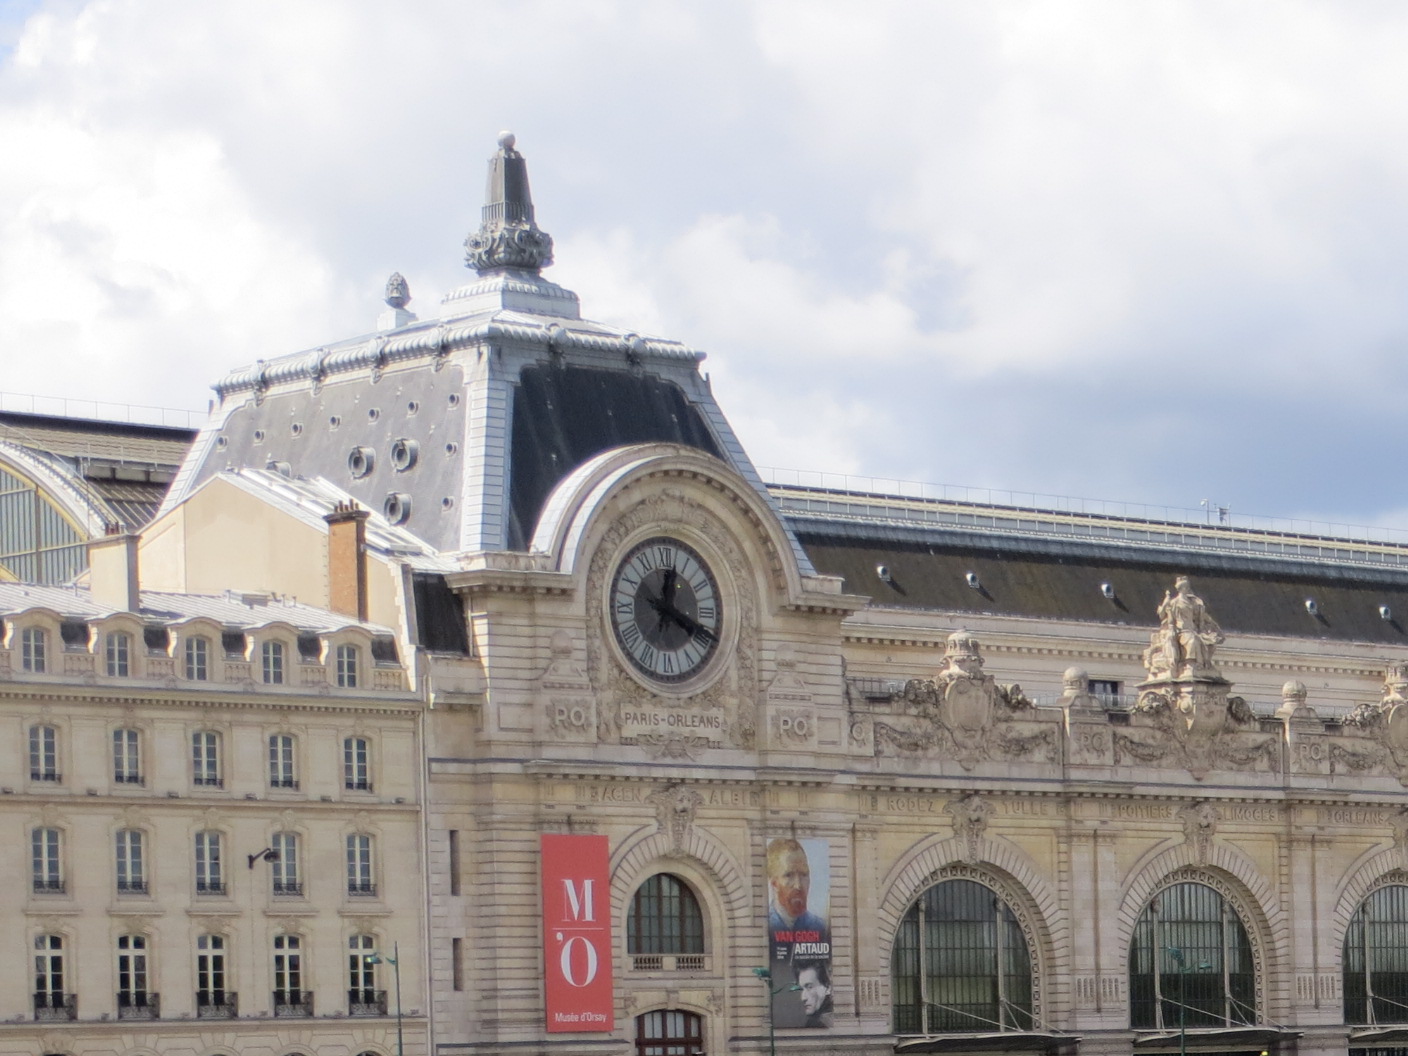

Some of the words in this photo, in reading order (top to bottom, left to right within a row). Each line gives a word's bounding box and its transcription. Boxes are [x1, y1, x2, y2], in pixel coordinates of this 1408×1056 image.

[636, 552, 653, 574] XI
[658, 547, 672, 568] XII
[622, 573, 638, 590] X
[698, 607, 714, 619] III
[555, 707, 586, 727] PO
[624, 712, 721, 730] PARIS-ORLEANS
[780, 715, 807, 735] PO
[601, 786, 642, 804] AGEN
[886, 796, 936, 814] RODEZ
[1001, 800, 1049, 816] TULLE
[1118, 805, 1173, 820] POITIERS
[1223, 807, 1277, 822] LIMOGES
[561, 879, 596, 922] M
[775, 930, 794, 942] VAN
[795, 931, 820, 942] GOGH
[795, 942, 830, 954] ARTAUD
[555, 1012, 579, 1023] Musée
[580, 1012, 607, 1024] d'Orsay
